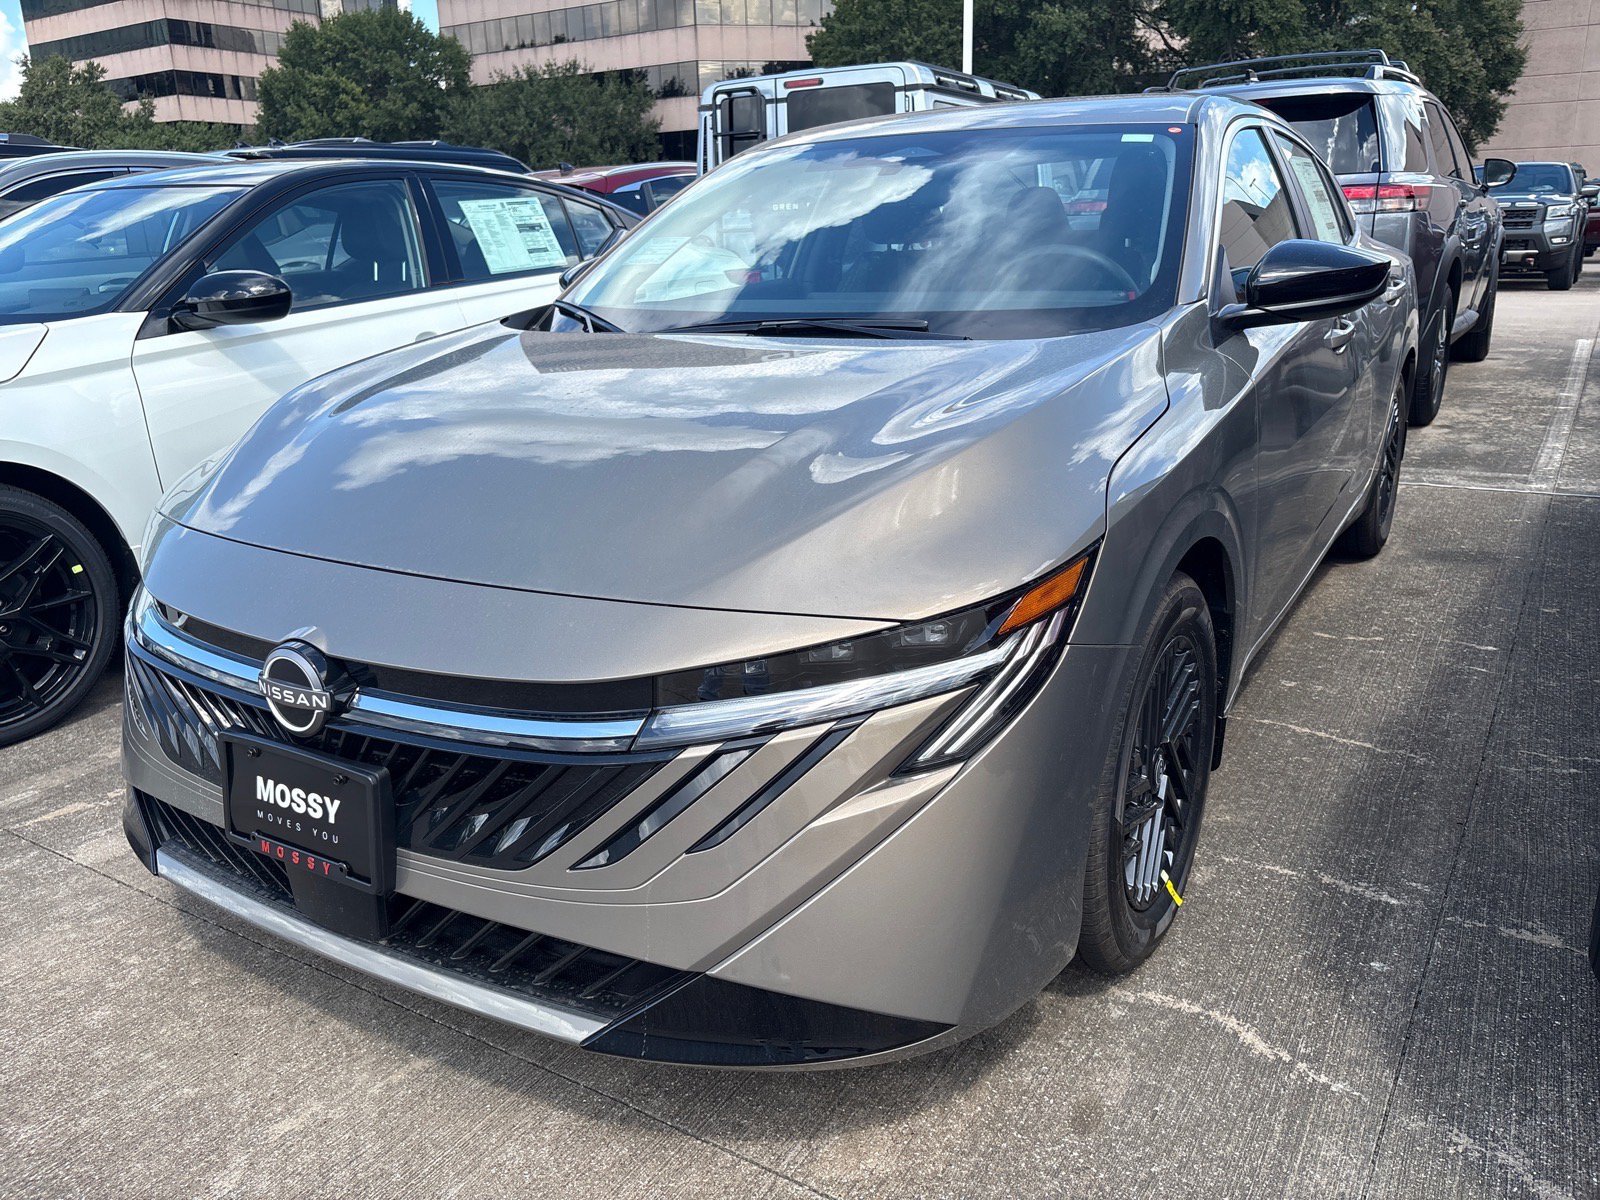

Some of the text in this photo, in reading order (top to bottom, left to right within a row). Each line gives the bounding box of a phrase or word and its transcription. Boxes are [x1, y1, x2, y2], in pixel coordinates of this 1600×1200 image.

[258, 680, 327, 708] NISSAN
[256, 775, 341, 824] MOSSY
[257, 810, 339, 844] MOVES YOU
[261, 840, 331, 875] MOSSY
